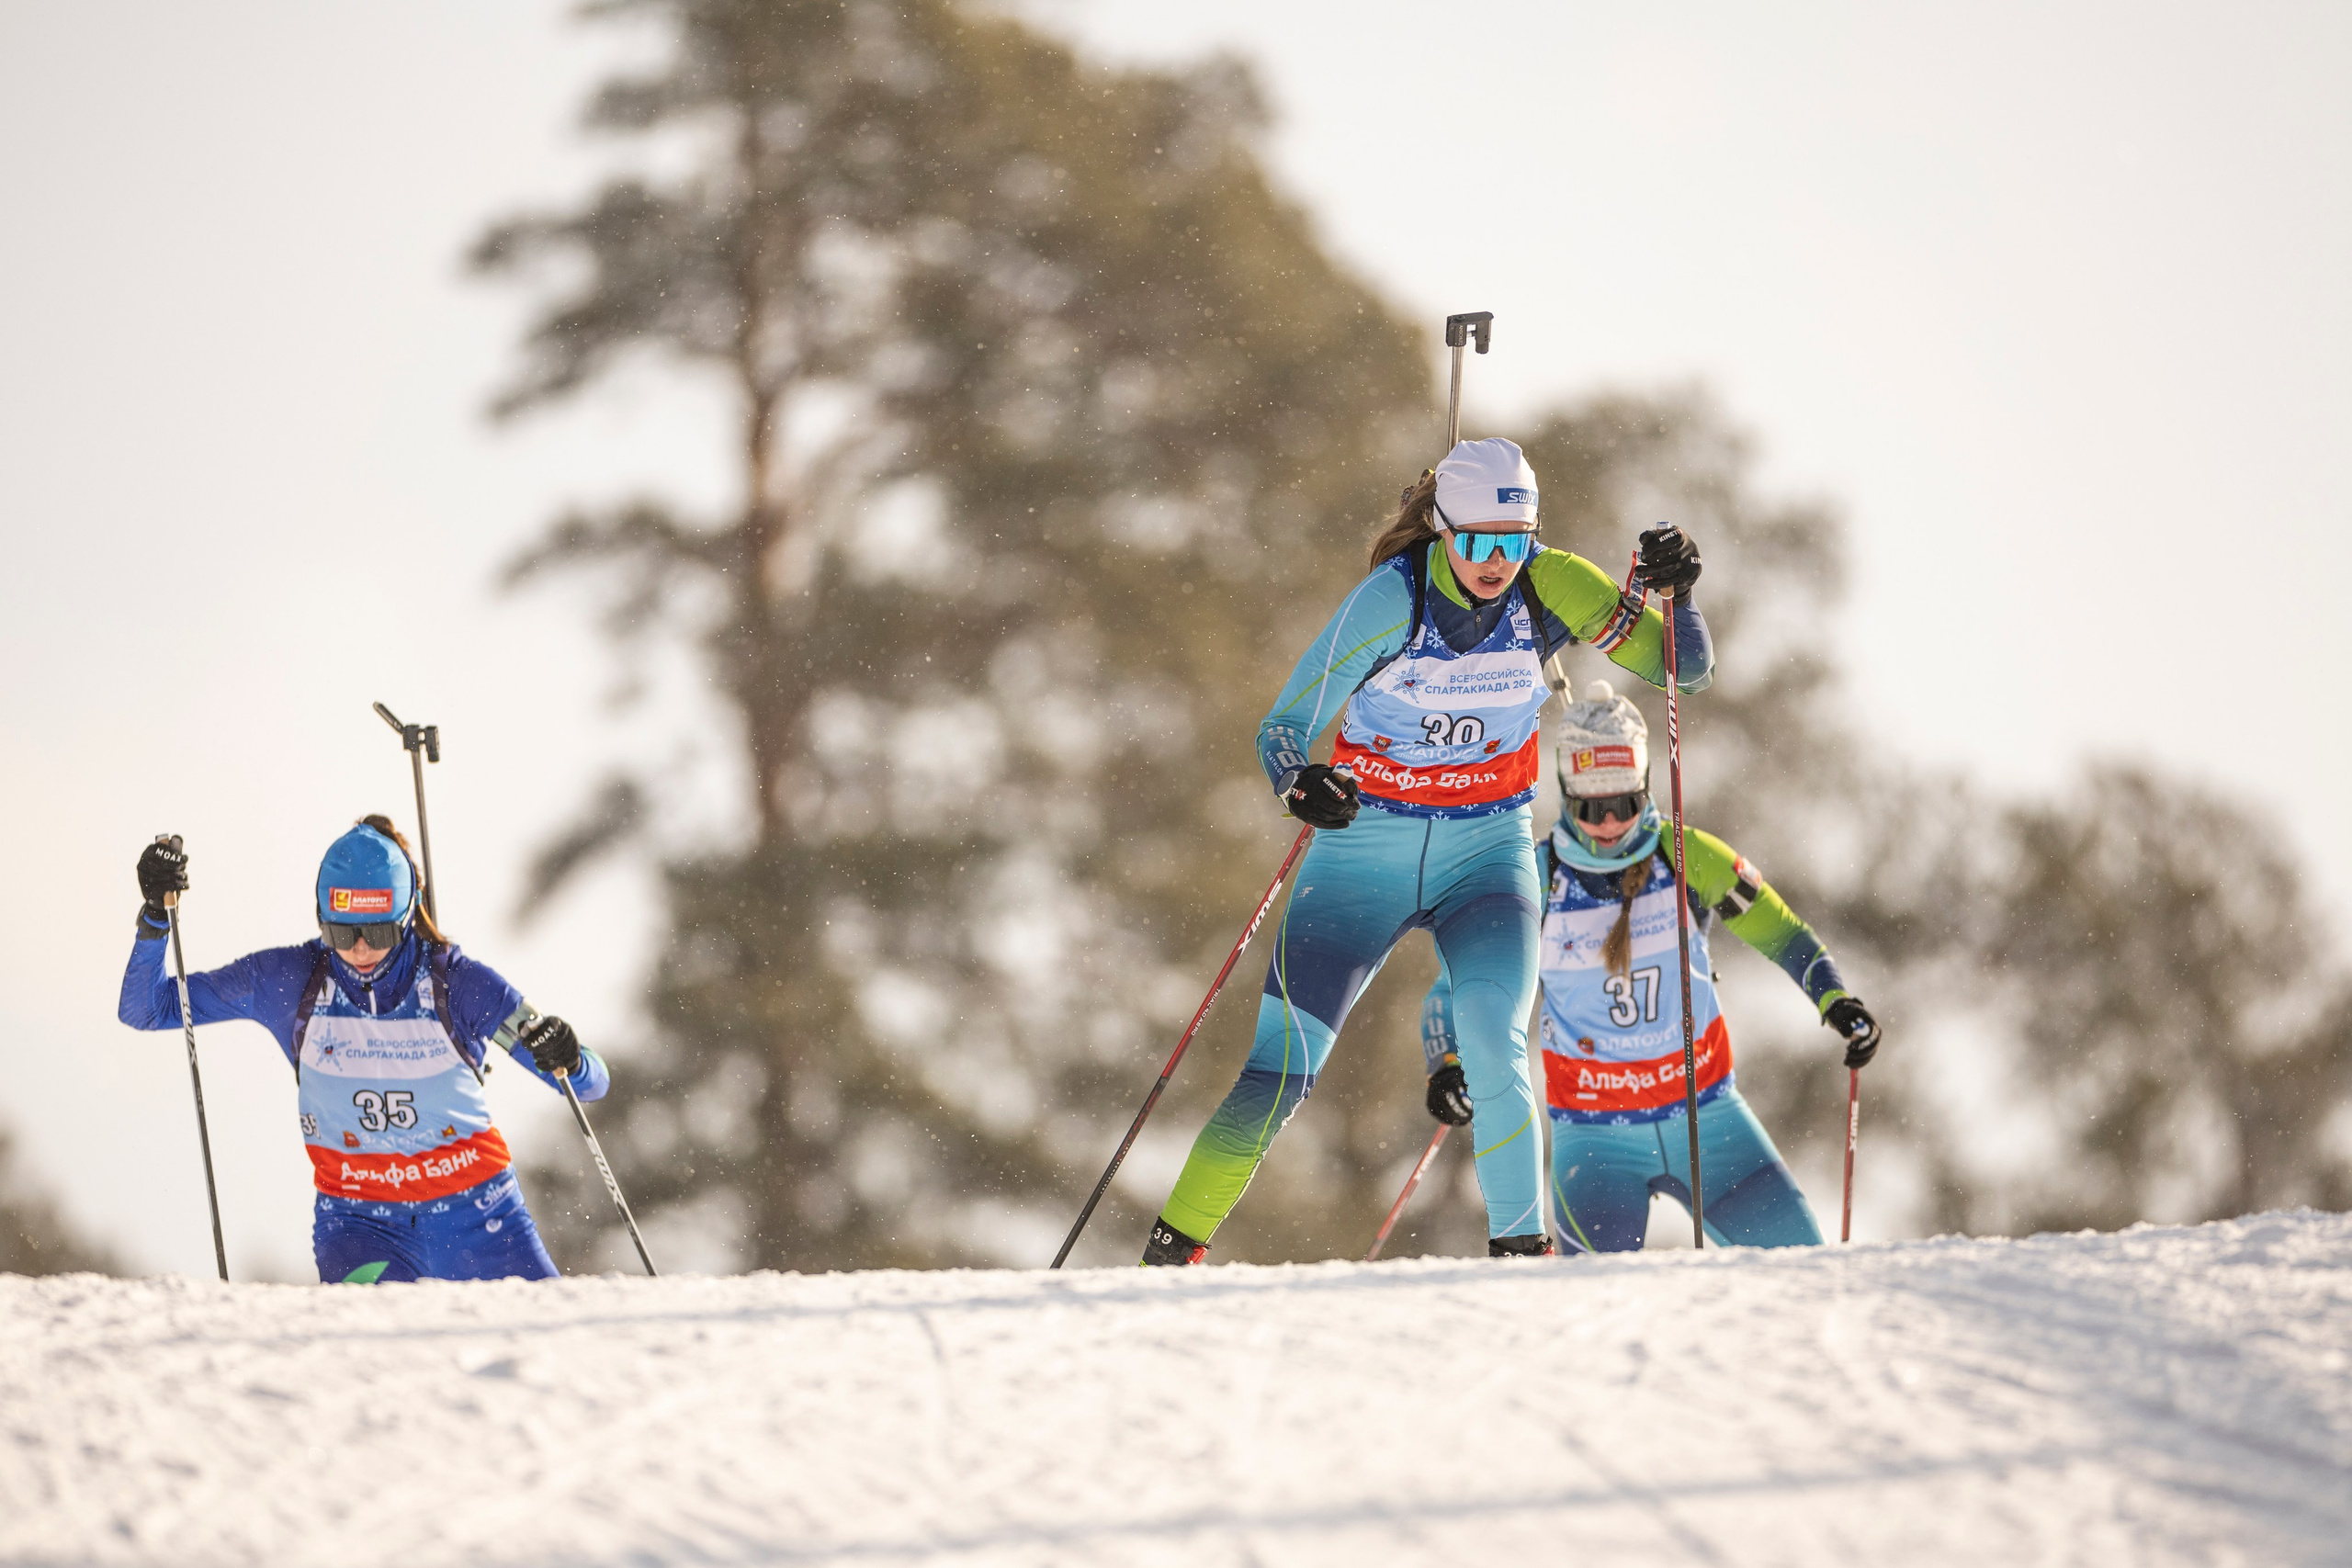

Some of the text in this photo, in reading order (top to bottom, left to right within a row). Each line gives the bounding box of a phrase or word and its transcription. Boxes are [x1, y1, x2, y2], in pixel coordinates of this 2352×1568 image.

[1425, 679, 1532, 695] СПАРТАКИАДА 202
[1265, 750, 1284, 777] BIATHLON
[154, 847, 182, 863] MOAX
[1603, 964, 1661, 1028] 37
[345, 1048, 426, 1061] СПАРТАКИАДА
[1577, 1066, 1656, 1094] Альфа
[353, 1089, 418, 1133] 35
[423, 1147, 481, 1179] Банк
[1153, 1227, 1173, 1245] 39
